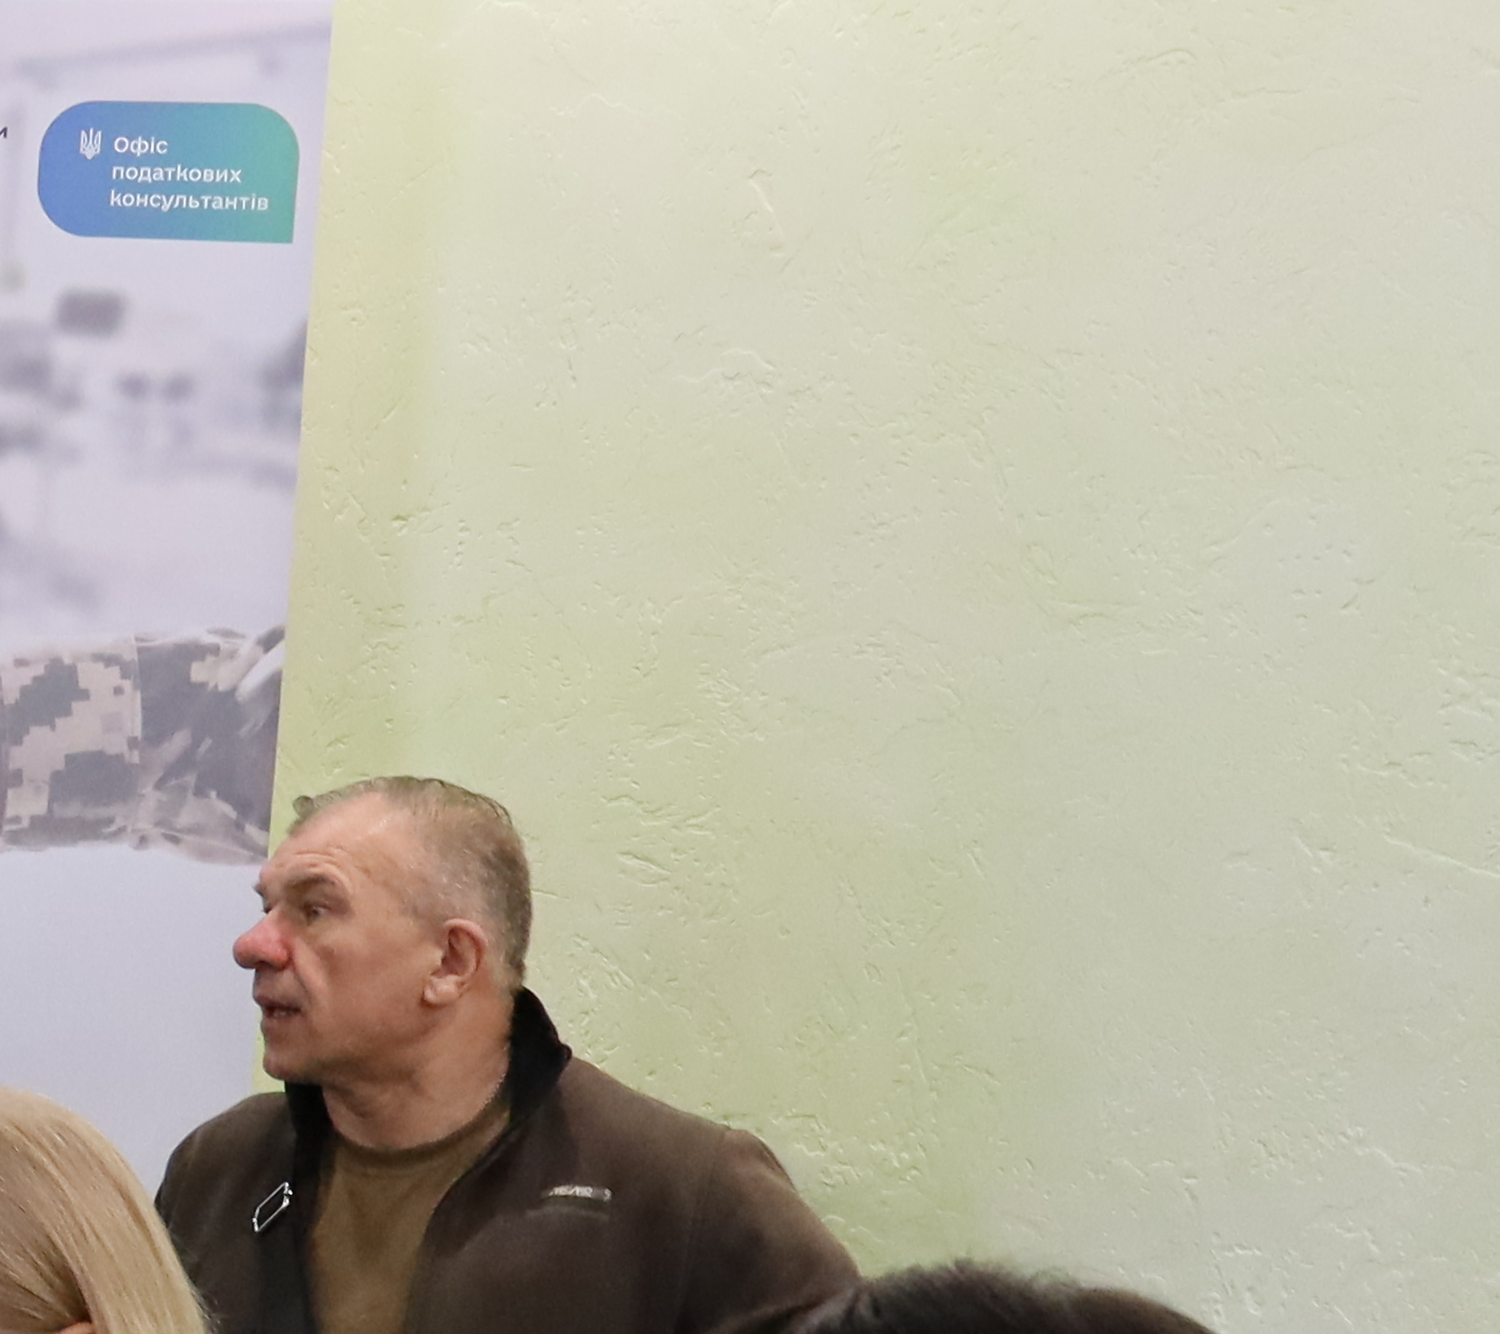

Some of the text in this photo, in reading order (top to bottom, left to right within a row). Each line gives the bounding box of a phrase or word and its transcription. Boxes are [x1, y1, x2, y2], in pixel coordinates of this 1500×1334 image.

[113, 136, 168, 156] Офіс
[112, 164, 242, 183] податкових
[110, 190, 269, 212] консультантів
